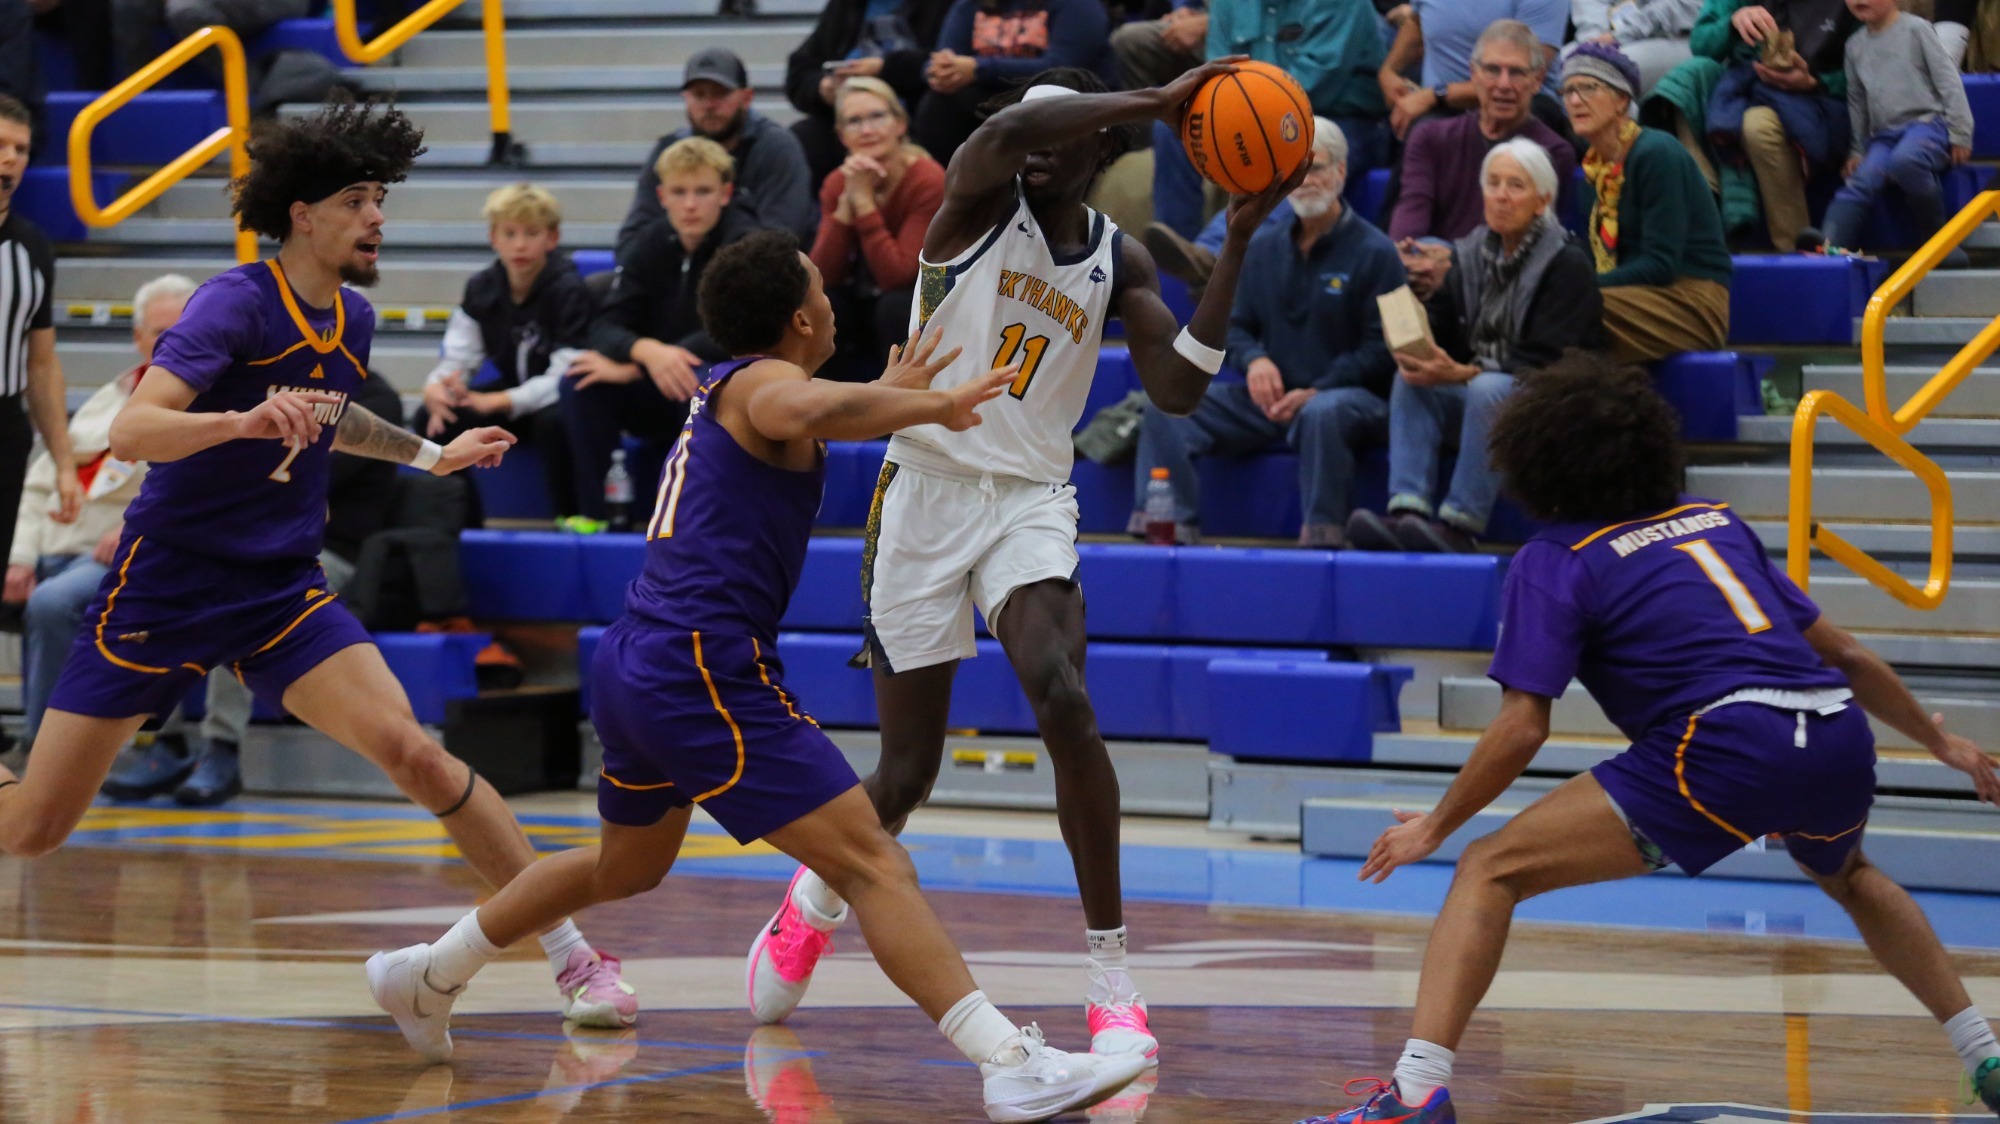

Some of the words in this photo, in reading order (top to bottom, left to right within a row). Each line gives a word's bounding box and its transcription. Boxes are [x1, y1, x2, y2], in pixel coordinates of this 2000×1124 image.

[998, 269, 1088, 345] SKYHAWKS
[991, 322, 1050, 401] 11
[268, 433, 291, 483] 2
[646, 428, 693, 542] 11
[1608, 511, 1730, 558] MUSTANGS
[1672, 538, 1773, 635] 1
